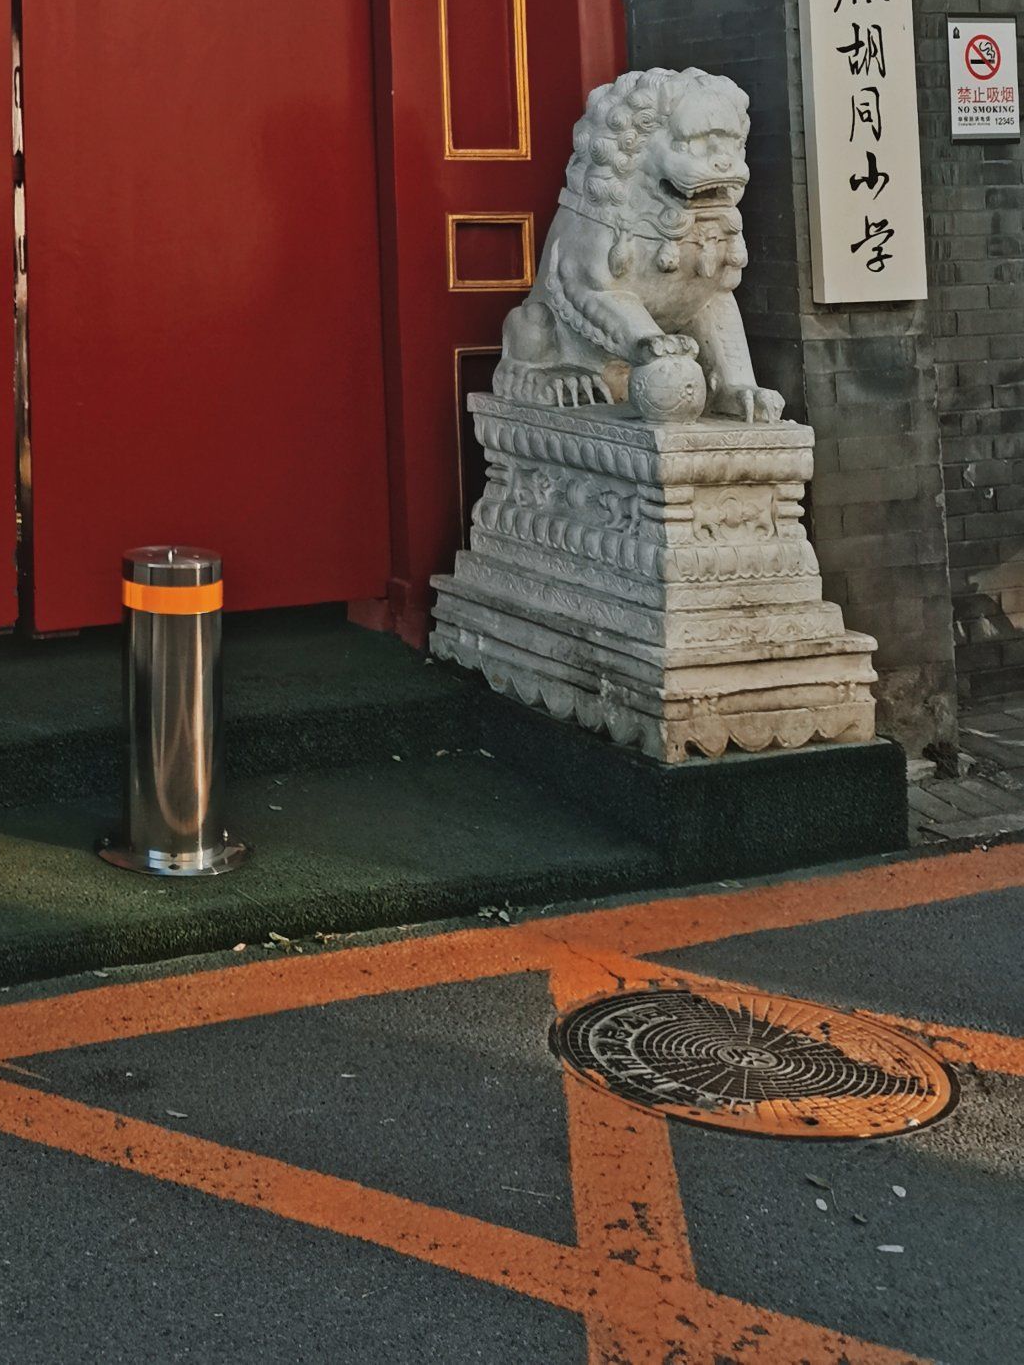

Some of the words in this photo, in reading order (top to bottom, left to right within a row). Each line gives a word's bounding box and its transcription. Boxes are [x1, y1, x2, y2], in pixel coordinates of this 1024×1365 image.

[957, 87, 1014, 104] 禁止吸烟
[958, 105, 970, 113] NO
[973, 105, 1015, 113] SMOKING
[995, 117, 1015, 126] 12345
